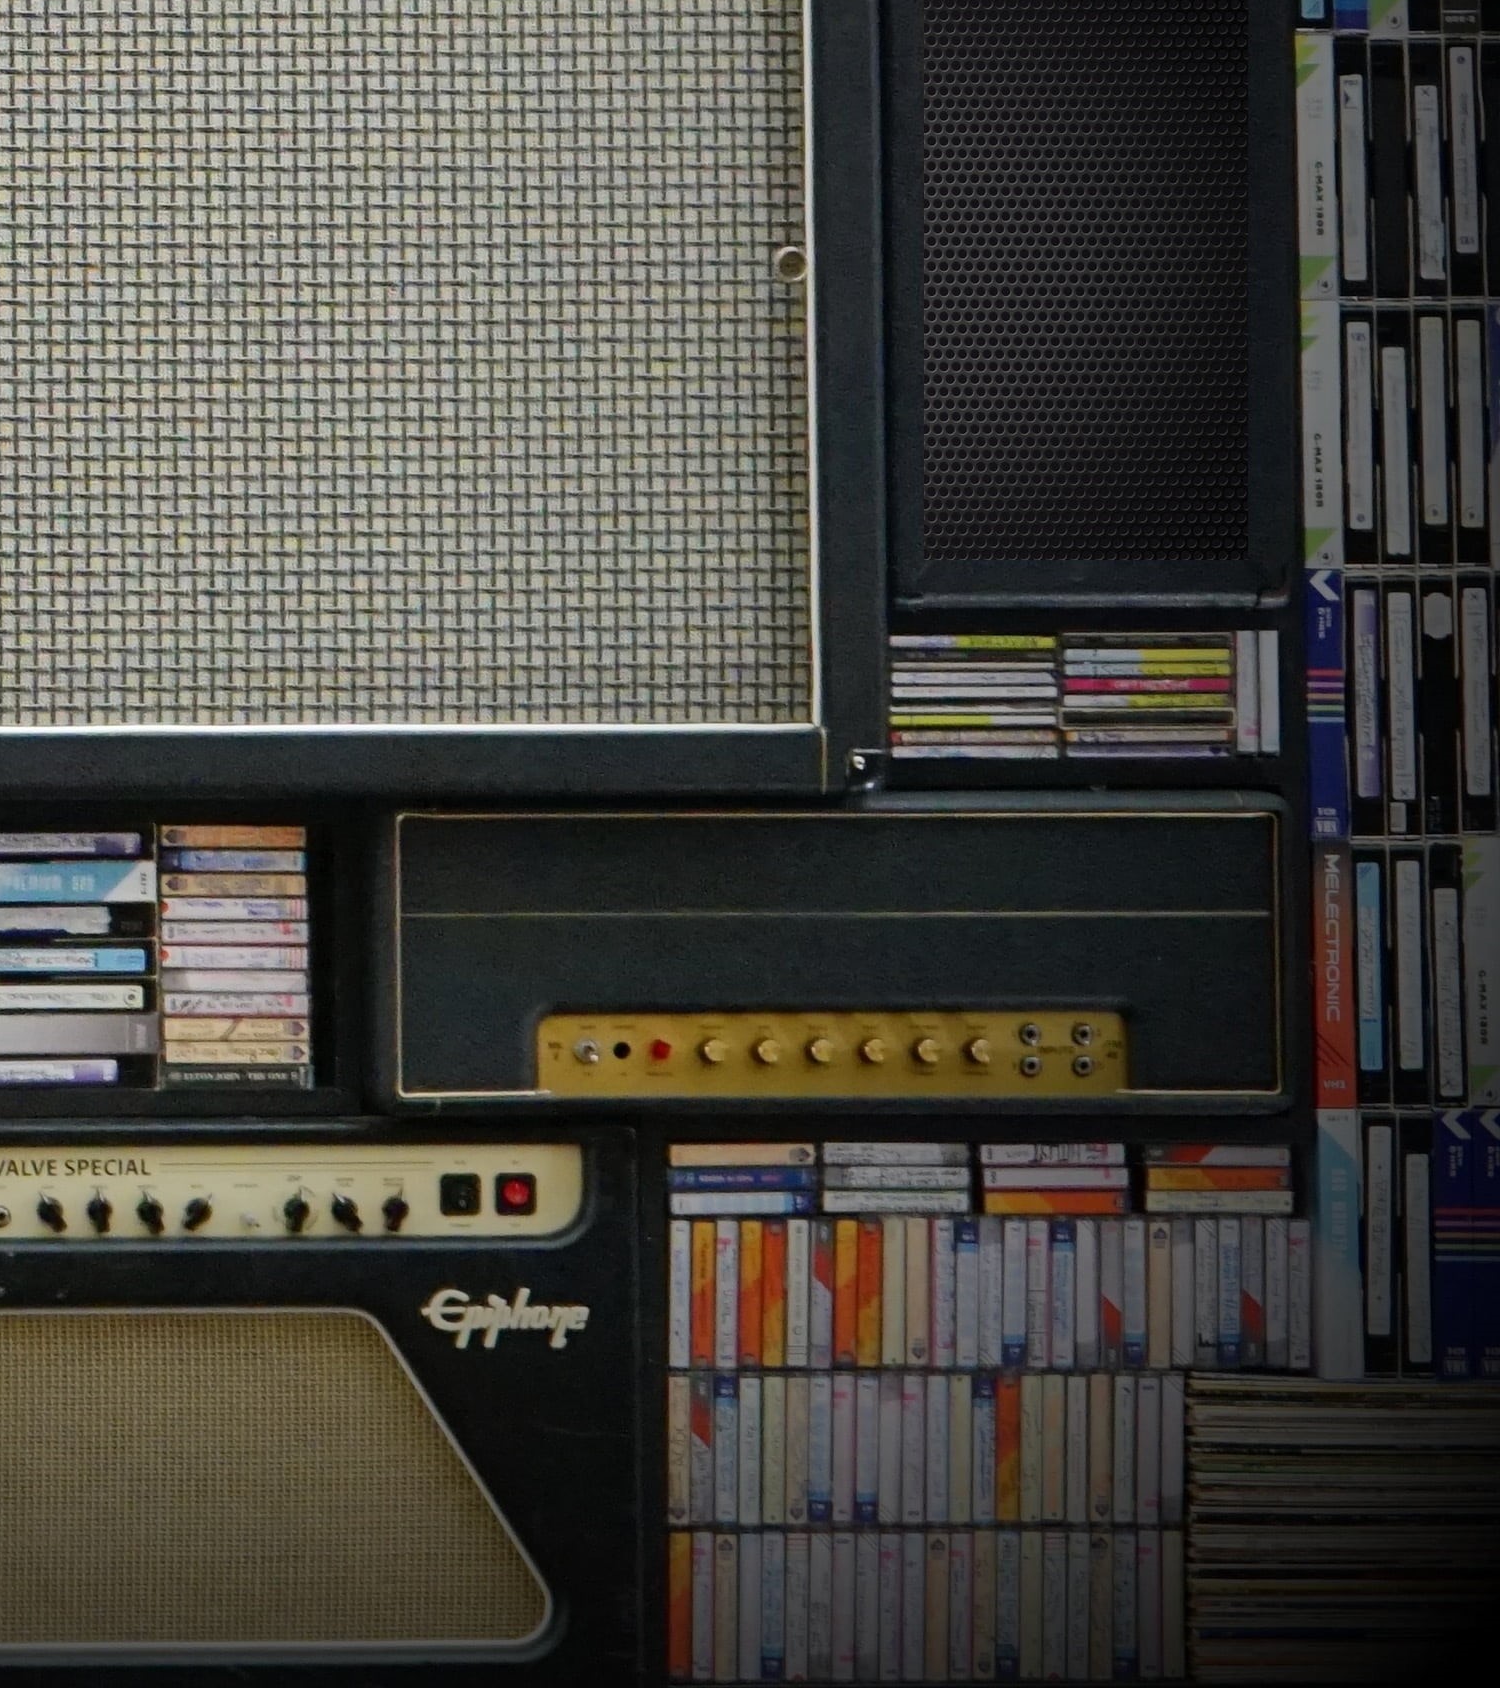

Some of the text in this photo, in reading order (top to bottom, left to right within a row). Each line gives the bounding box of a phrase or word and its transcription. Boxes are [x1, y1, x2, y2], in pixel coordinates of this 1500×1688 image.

[1324, 854, 1341, 1023] MELECTRONIC
[63, 1157, 152, 1177] SPECIAL
[420, 1288, 589, 1348] Epiphone
